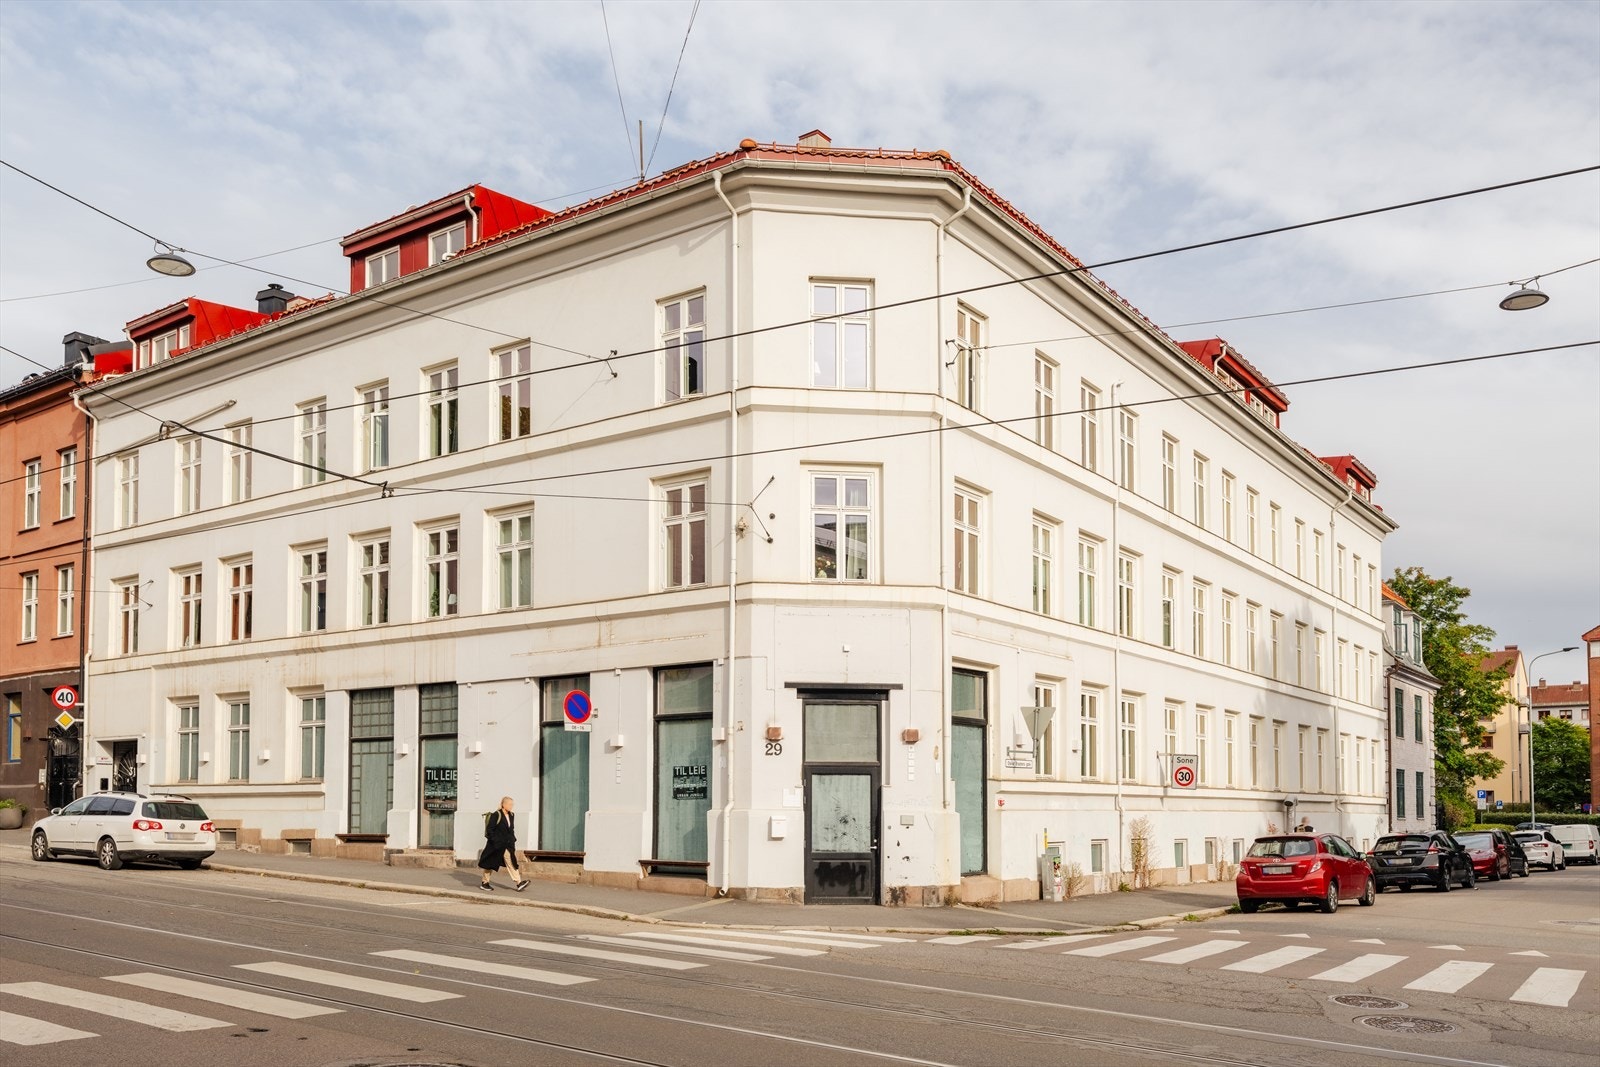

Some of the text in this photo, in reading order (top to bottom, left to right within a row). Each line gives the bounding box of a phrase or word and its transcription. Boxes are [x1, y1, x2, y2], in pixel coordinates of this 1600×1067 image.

[58, 692, 73, 703] 40
[765, 743, 782, 756] 29
[426, 769, 458, 780] TIL LEIE
[675, 766, 705, 775] TIL LEIE
[1178, 772, 1190, 781] 30
